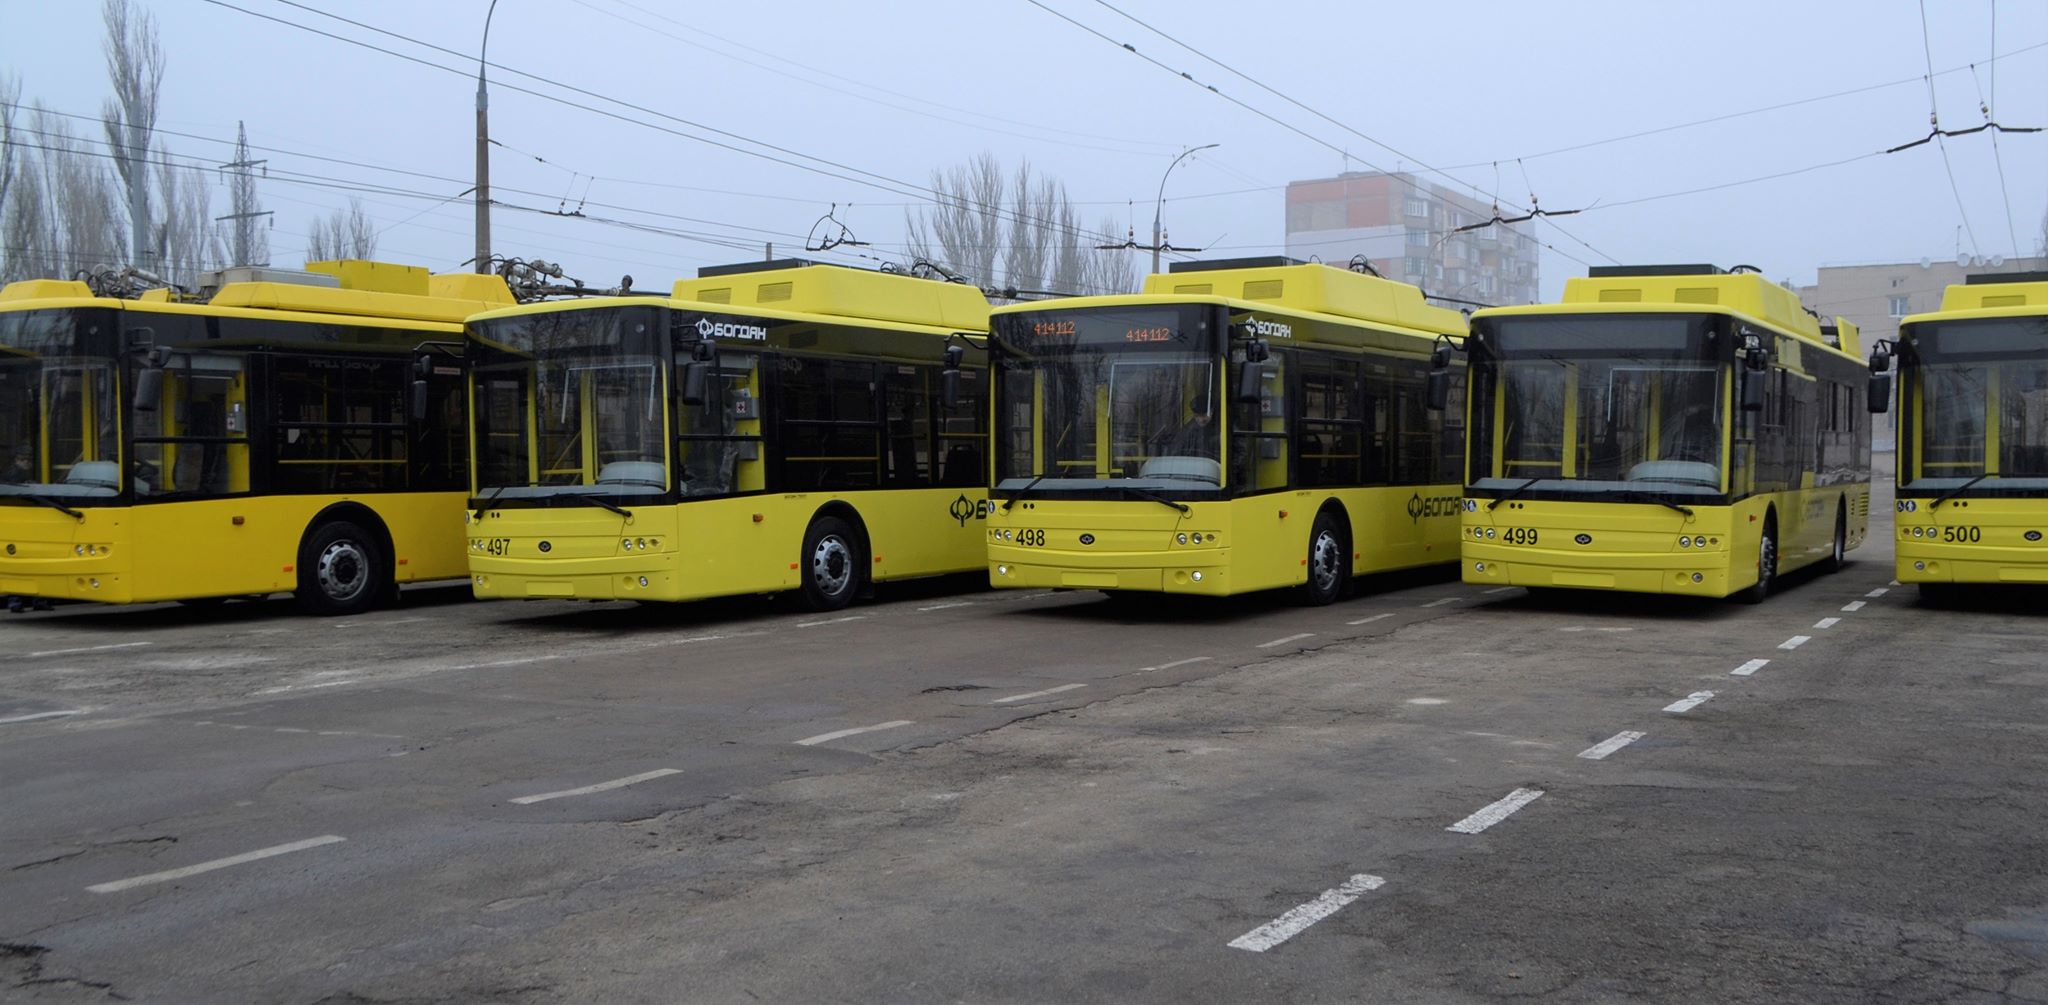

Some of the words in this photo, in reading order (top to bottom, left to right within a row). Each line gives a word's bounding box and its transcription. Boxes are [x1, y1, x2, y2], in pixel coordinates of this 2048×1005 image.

[714, 322, 767, 340] БОГДАН
[1257, 320, 1292, 338] БОГДАН
[1423, 496, 1462, 517] БОГДА
[1015, 529, 1045, 546] 498
[1503, 527, 1538, 545] 499
[1944, 526, 1981, 542] 500
[487, 538, 511, 555] 497
